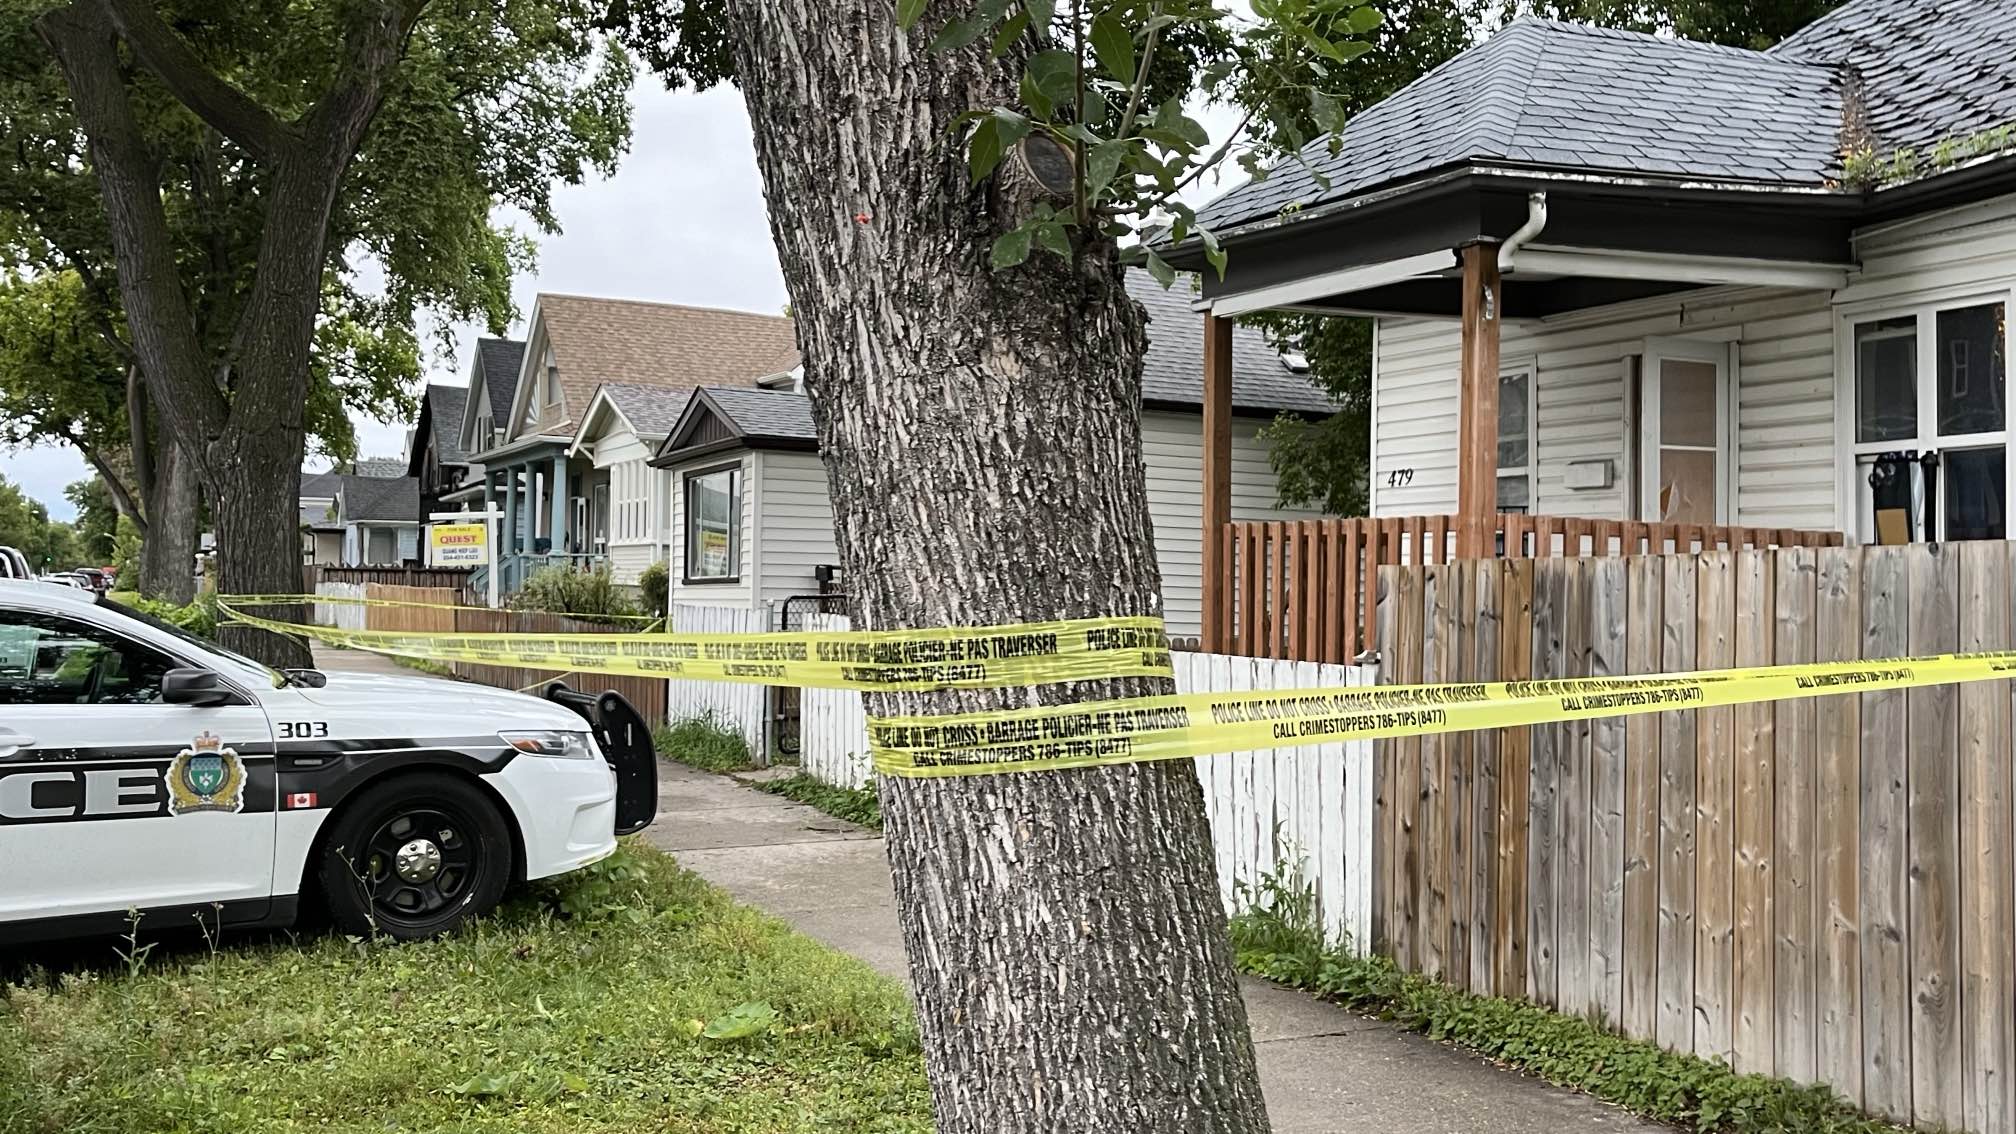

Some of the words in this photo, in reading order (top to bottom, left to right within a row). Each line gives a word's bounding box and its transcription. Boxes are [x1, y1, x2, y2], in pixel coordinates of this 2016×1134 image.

[1387, 468, 1414, 487] 479
[440, 535, 477, 544] QUEST
[967, 637, 990, 660] PAS
[991, 633, 1058, 659] TRAVERSER
[1087, 629, 1121, 651] POLICE
[945, 664, 986, 685] (8477)
[1796, 676, 1814, 688] CALL
[1211, 702, 1245, 724] POLICE
[1244, 701, 1267, 721] LINE
[1266, 699, 1281, 720] DO
[1280, 698, 1300, 719] NOT
[1299, 696, 1330, 716] CROSS
[1333, 692, 1376, 714] BARRAGE
[1425, 687, 1445, 706] PAS
[1443, 685, 1490, 703] TRAVERSER
[1562, 697, 1582, 711] CALL
[1583, 691, 1646, 709] CRIMESTOPPERS
[1645, 688, 1680, 705] 786-TIPS
[1680, 687, 1704, 704] (8477)
[278, 722, 328, 738] 303
[911, 726, 922, 747] DO
[942, 723, 979, 747] CROSS
[986, 719, 1039, 743] BARRAGE
[1042, 712, 1111, 739] POLICIER-NE
[1113, 711, 1134, 733] PAS
[1135, 706, 1191, 731] TRAVERSER
[1274, 722, 1297, 738] CALL
[1299, 714, 1376, 737] CRIMESTOPPERS
[1376, 711, 1417, 730] 786-TIPS
[1418, 709, 1447, 728] (8477)
[914, 751, 938, 766] CALL
[939, 744, 1035, 766] CRIMESTOPPERS
[1037, 740, 1093, 760] 786-TIPS
[1096, 737, 1132, 758] (8477)
